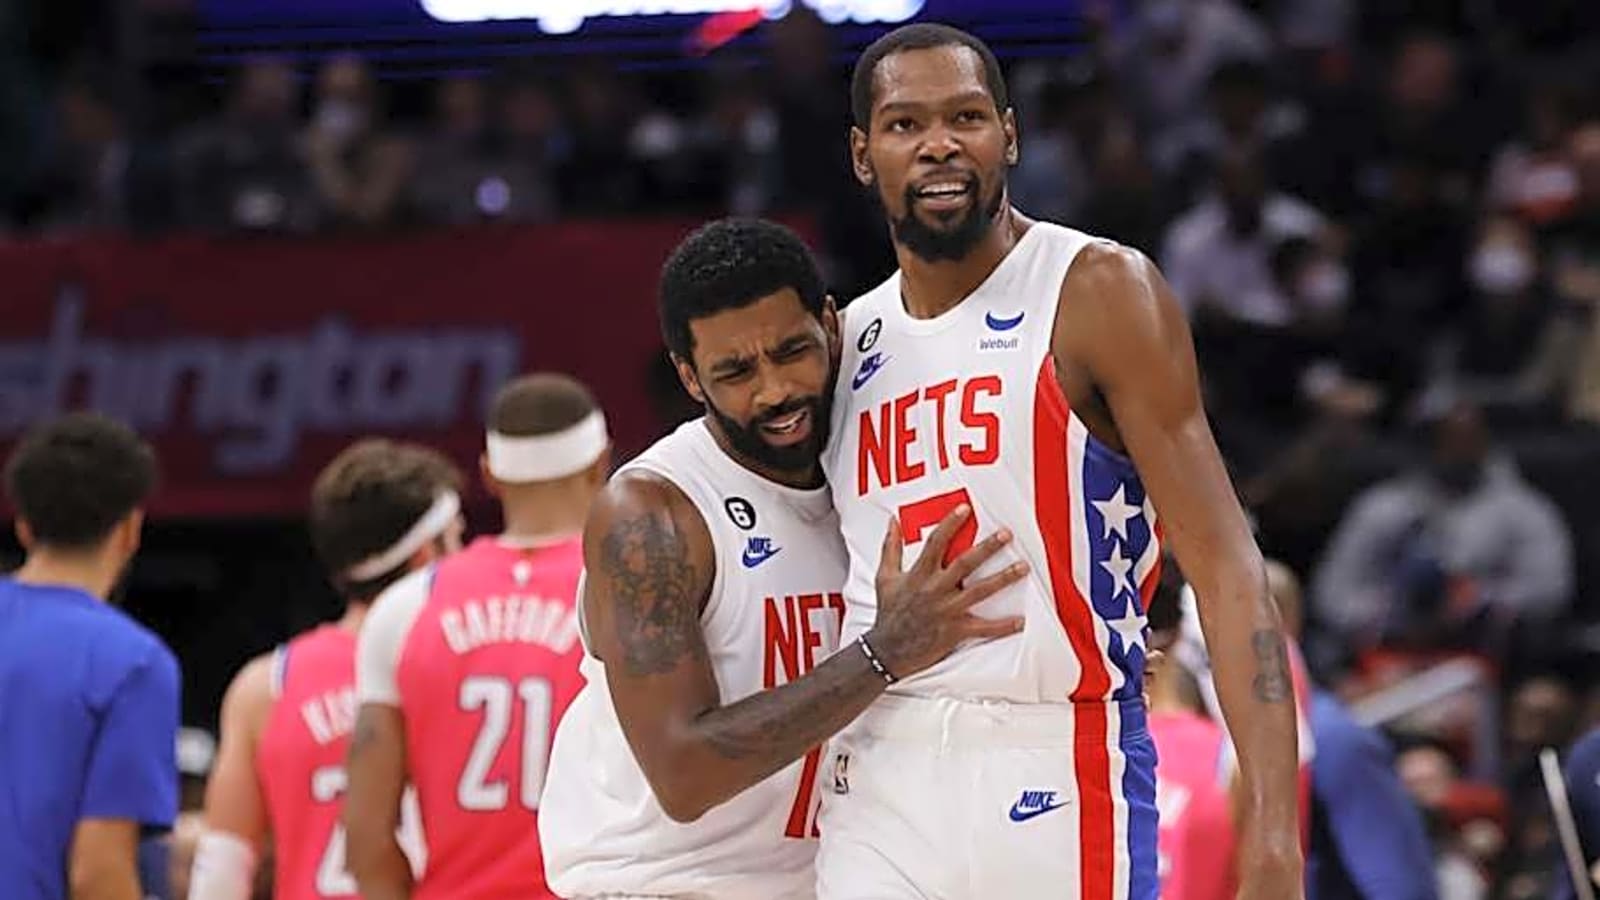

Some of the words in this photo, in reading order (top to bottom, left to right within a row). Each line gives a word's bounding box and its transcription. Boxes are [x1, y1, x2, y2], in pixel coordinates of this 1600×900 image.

[979, 337, 1019, 350] Webull
[859, 375, 1002, 496] NETS
[727, 501, 752, 527] 6
[899, 487, 979, 570] 7
[747, 536, 772, 554] NIKE
[457, 674, 553, 811] 21
[1019, 790, 1057, 808] NIKE
